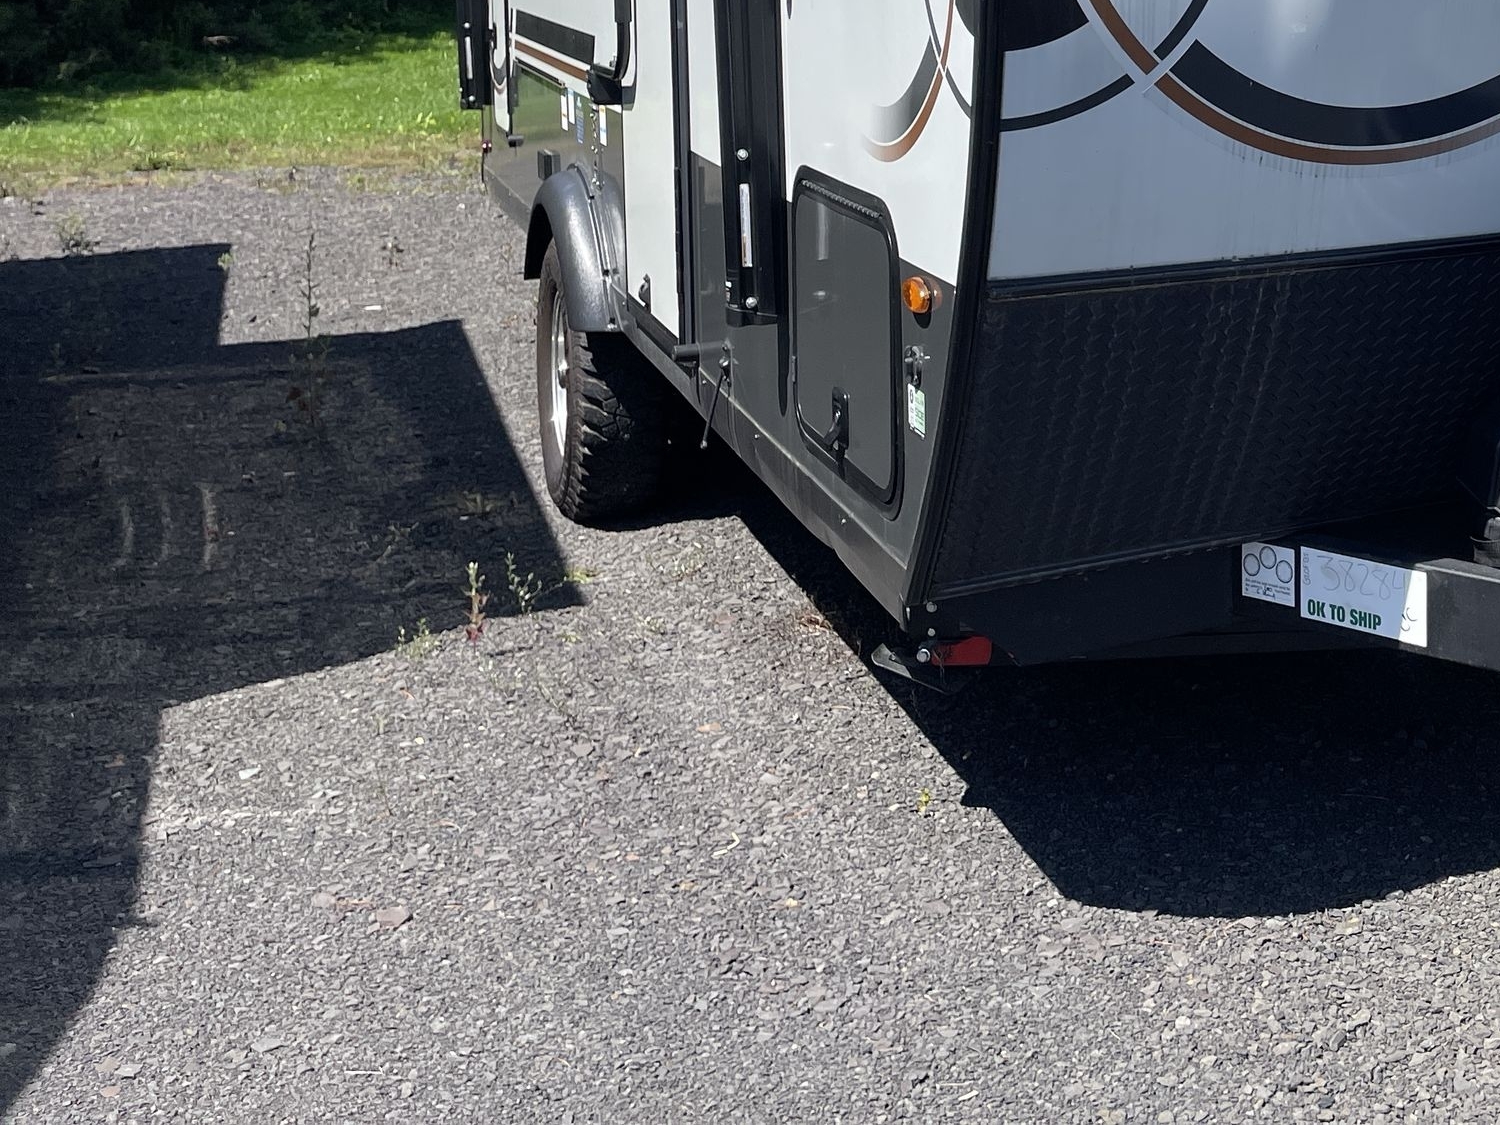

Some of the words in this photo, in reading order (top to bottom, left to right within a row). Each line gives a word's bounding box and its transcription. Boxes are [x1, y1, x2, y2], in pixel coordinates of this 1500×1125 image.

[1307, 598, 1327, 619] OK
[1328, 602, 1346, 623] TO
[1349, 608, 1383, 631] SHIP
